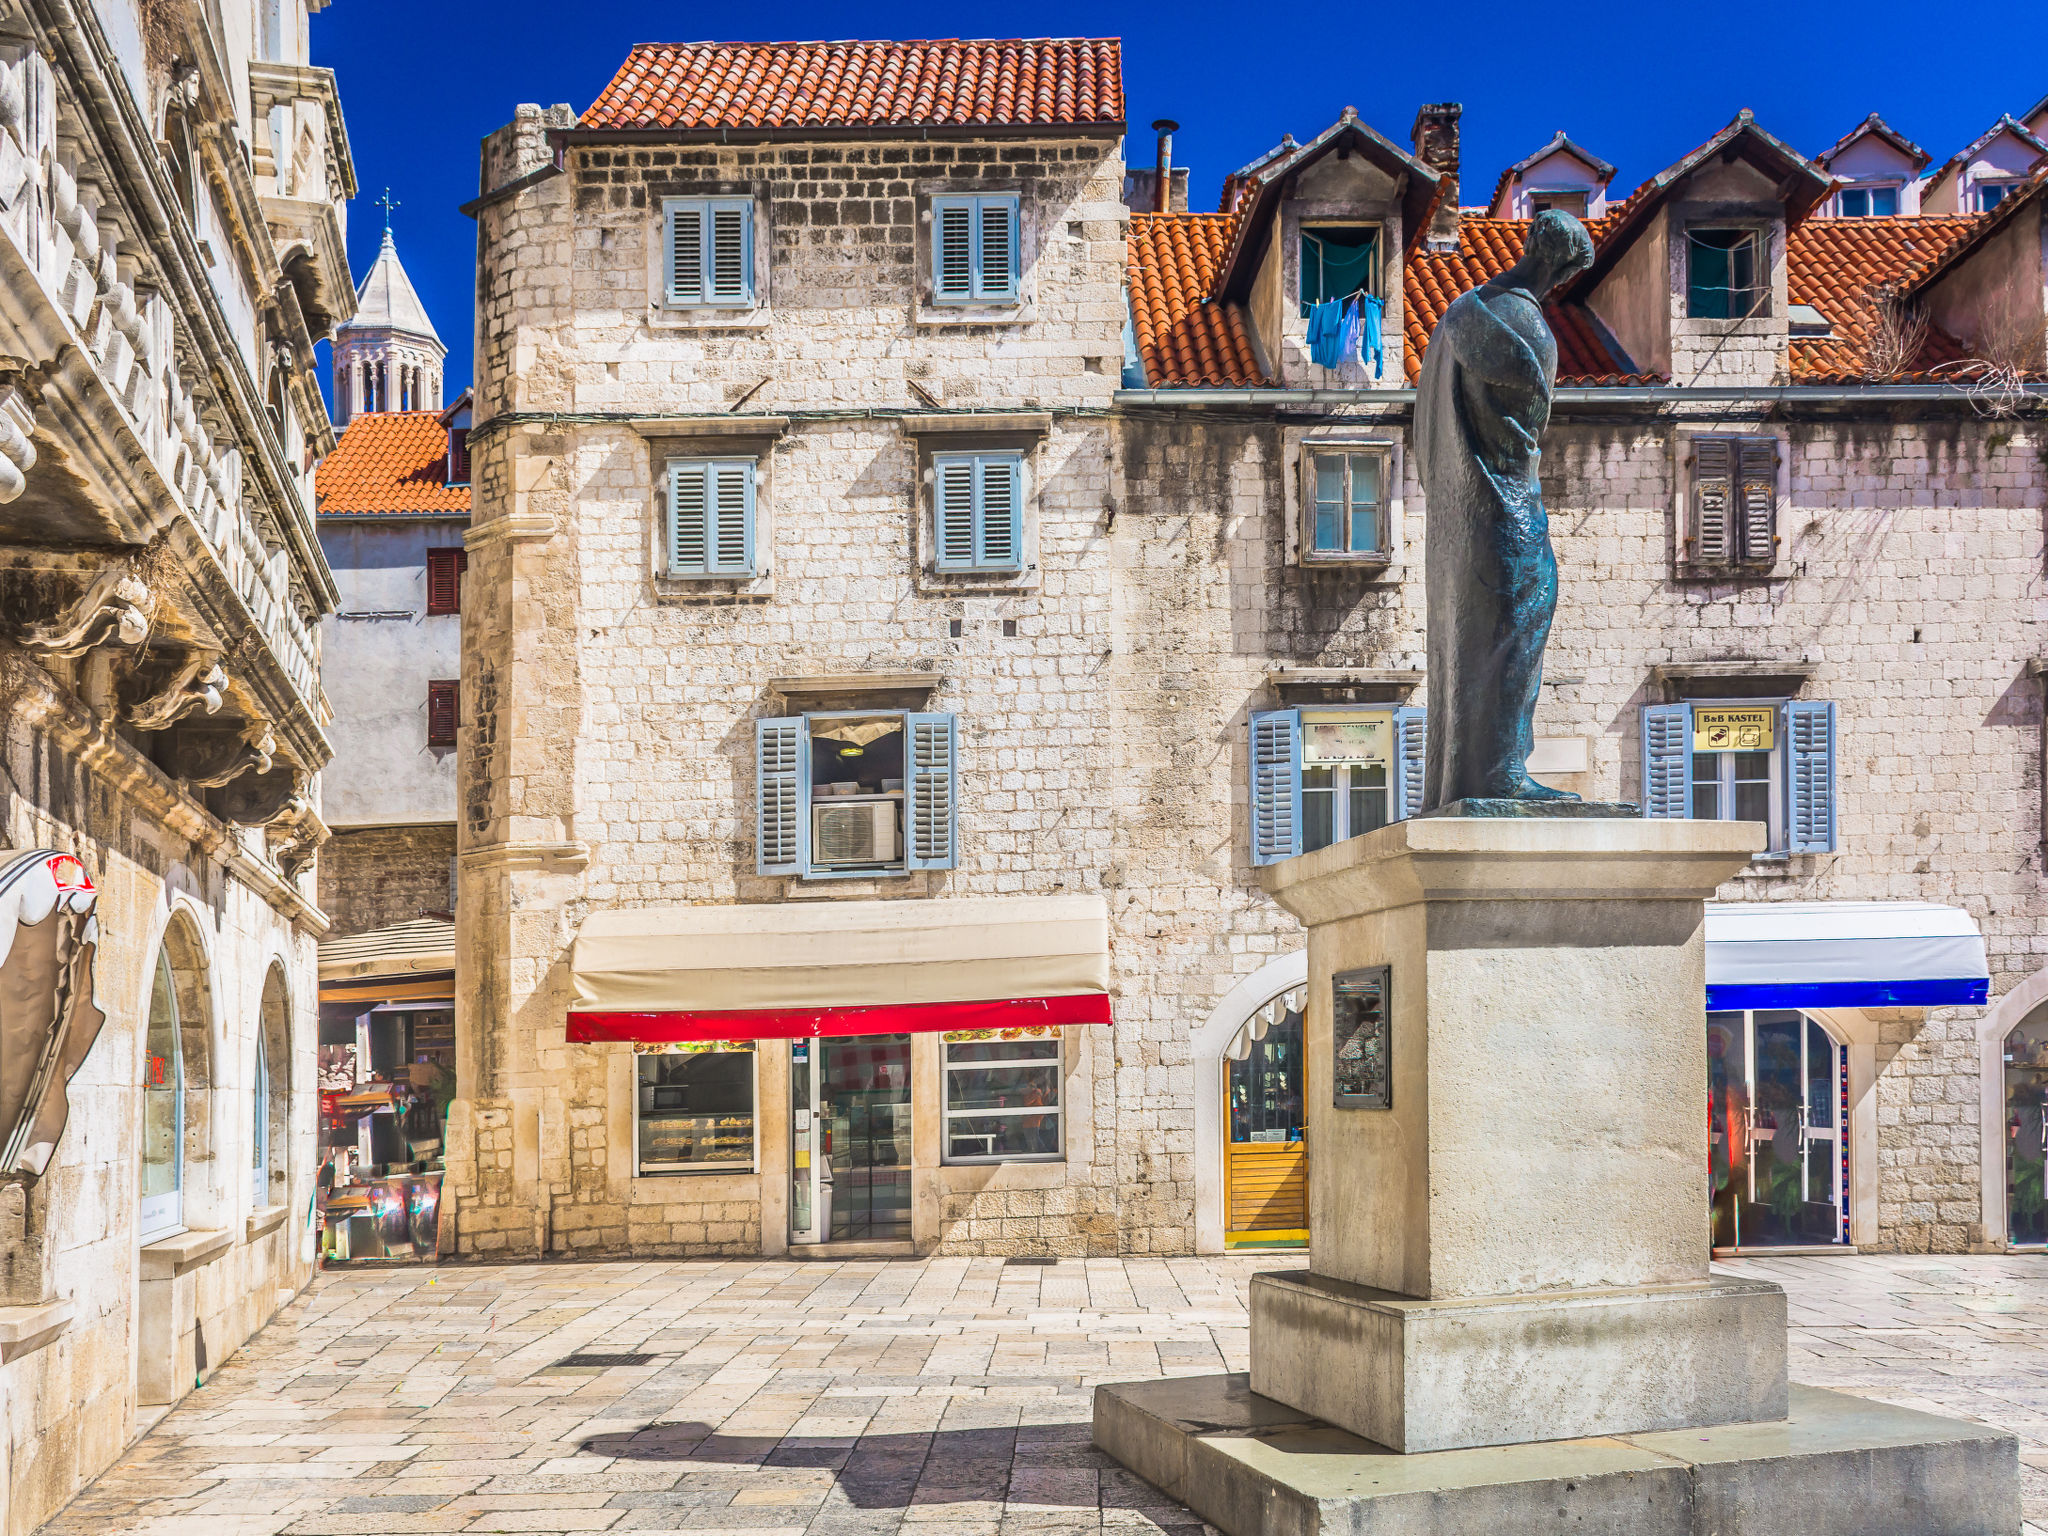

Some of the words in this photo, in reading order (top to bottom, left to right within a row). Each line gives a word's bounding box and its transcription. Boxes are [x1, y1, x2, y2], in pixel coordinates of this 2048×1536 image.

[1703, 714, 1725, 722] B&B
[1728, 714, 1765, 722] KASTEL
[152, 1056, 165, 1084] PBZ
